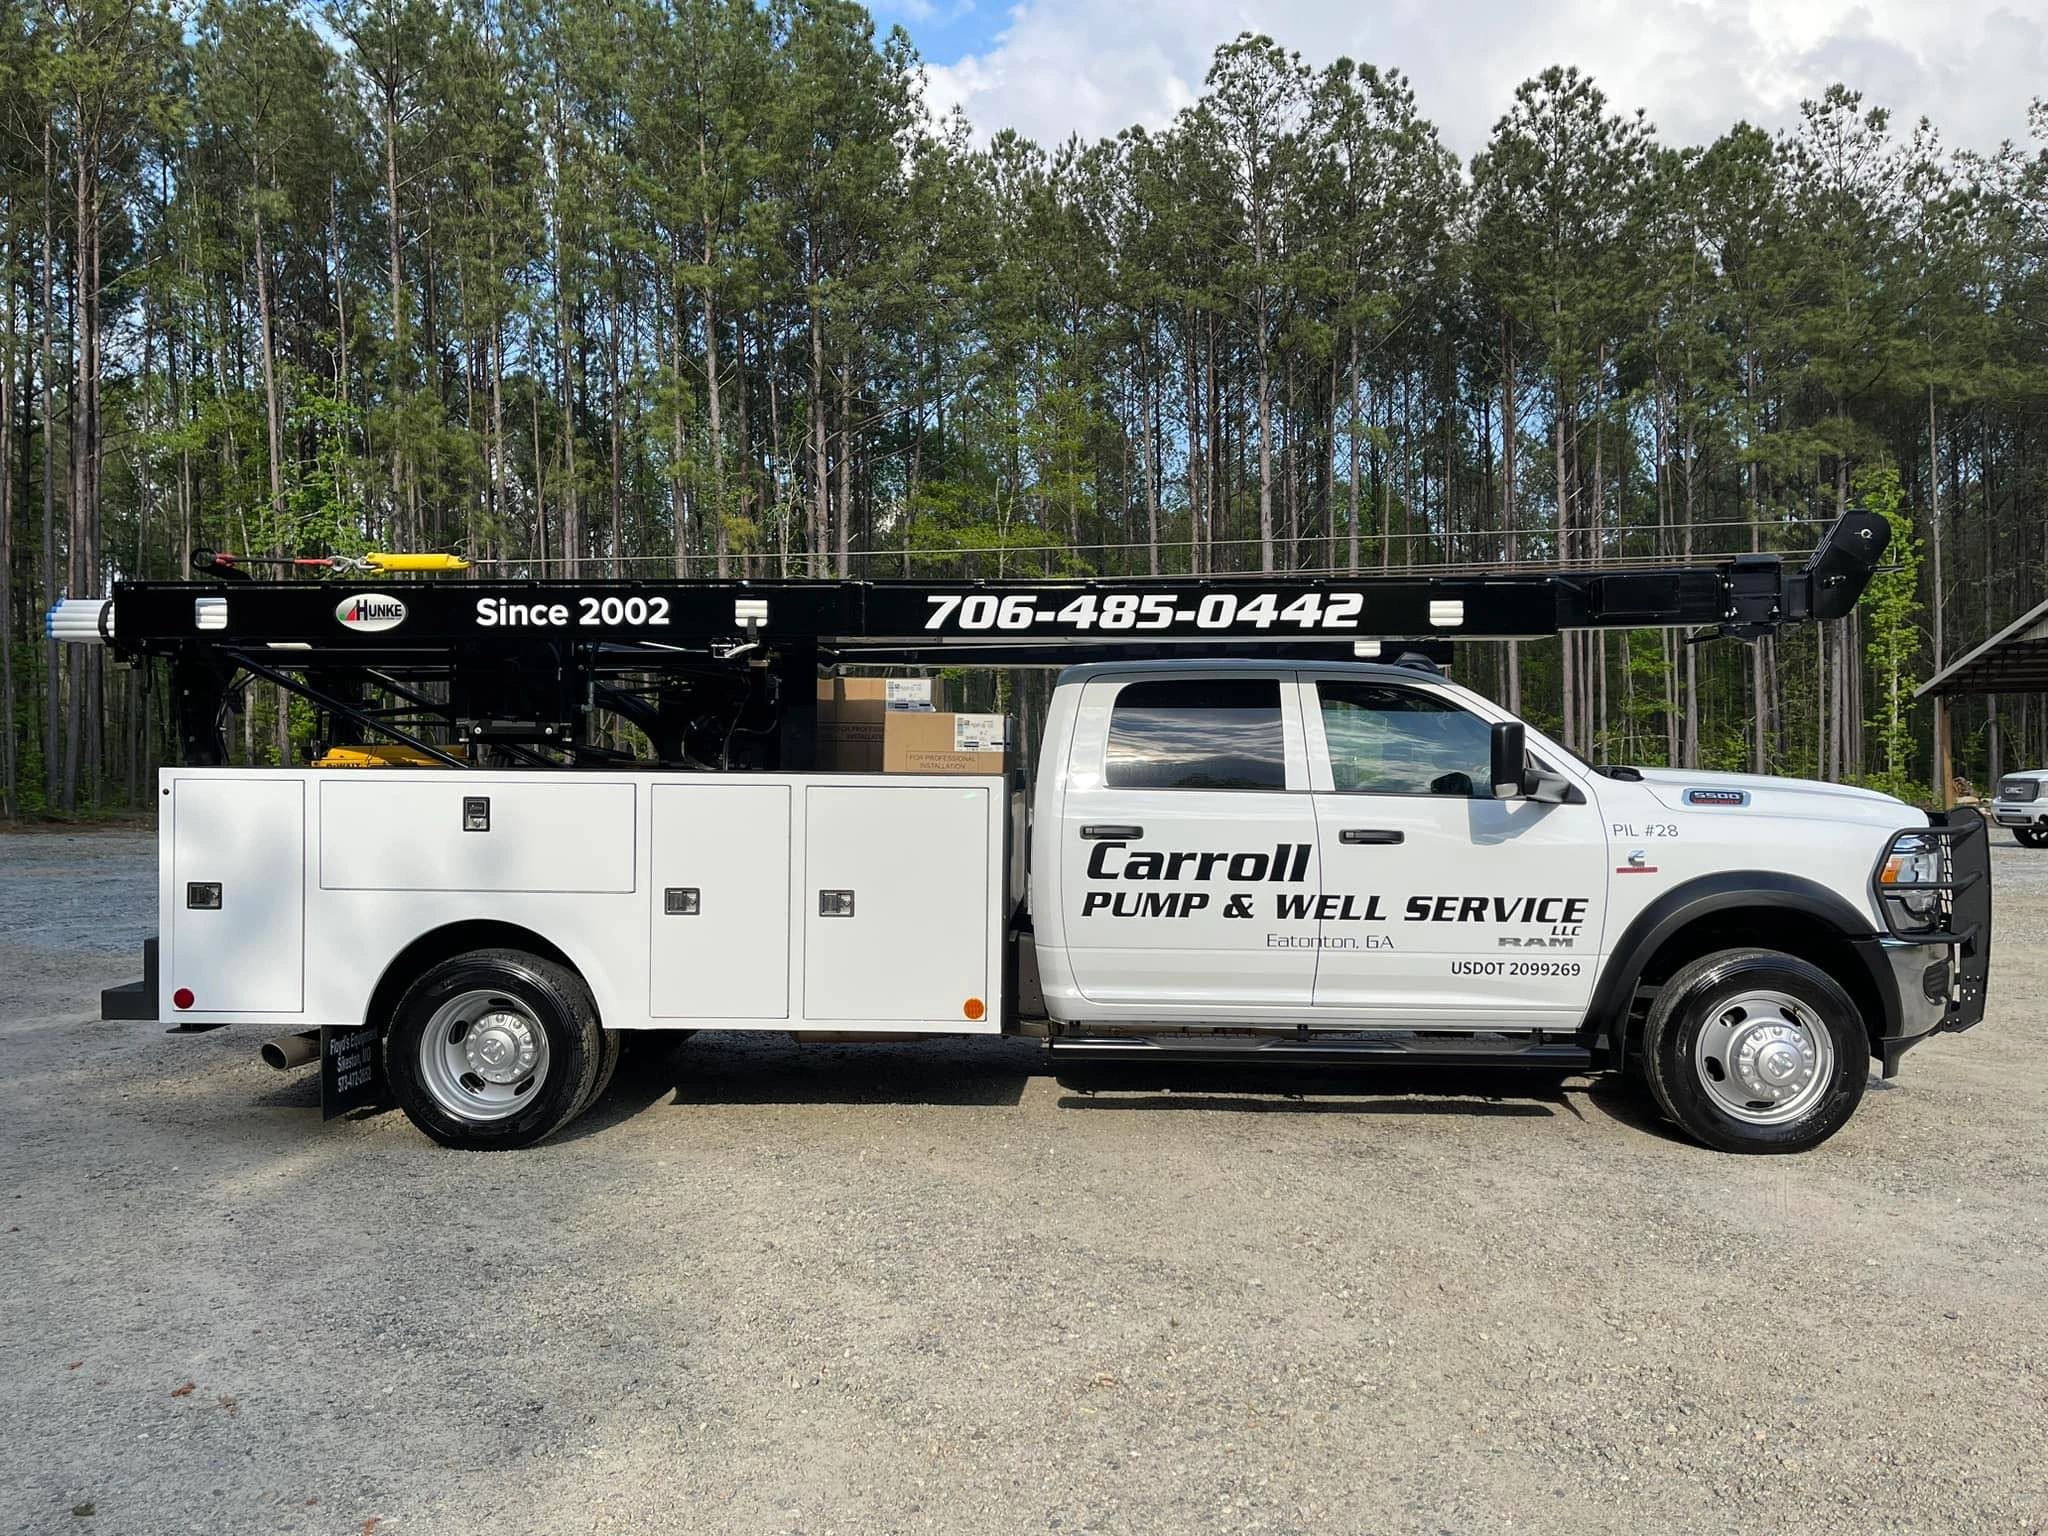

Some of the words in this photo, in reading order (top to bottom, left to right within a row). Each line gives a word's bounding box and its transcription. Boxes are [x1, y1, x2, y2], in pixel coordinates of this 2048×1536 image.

[356, 599, 402, 621] HUNKE
[476, 597, 569, 626] Since
[578, 596, 670, 626] 2002
[924, 592, 1364, 630] 706-485-0442
[924, 754, 976, 762] PROFESSIONAL
[1694, 791, 1740, 800] 5500
[1613, 824, 1639, 837] PIL
[1645, 824, 1679, 837] #28
[1087, 842, 1312, 882] Carroll
[1081, 892, 1210, 918] PUMP
[1223, 893, 1255, 919] &
[1276, 894, 1388, 921] WELL
[1404, 896, 1589, 924] SERVICE
[1551, 926, 1582, 936] LLC
[1266, 933, 1360, 950] Eatonton,
[1366, 935, 1394, 950] GA
[1498, 937, 1574, 947] RAM
[1451, 961, 1505, 976] USDOT
[1509, 962, 1581, 977] 2099269
